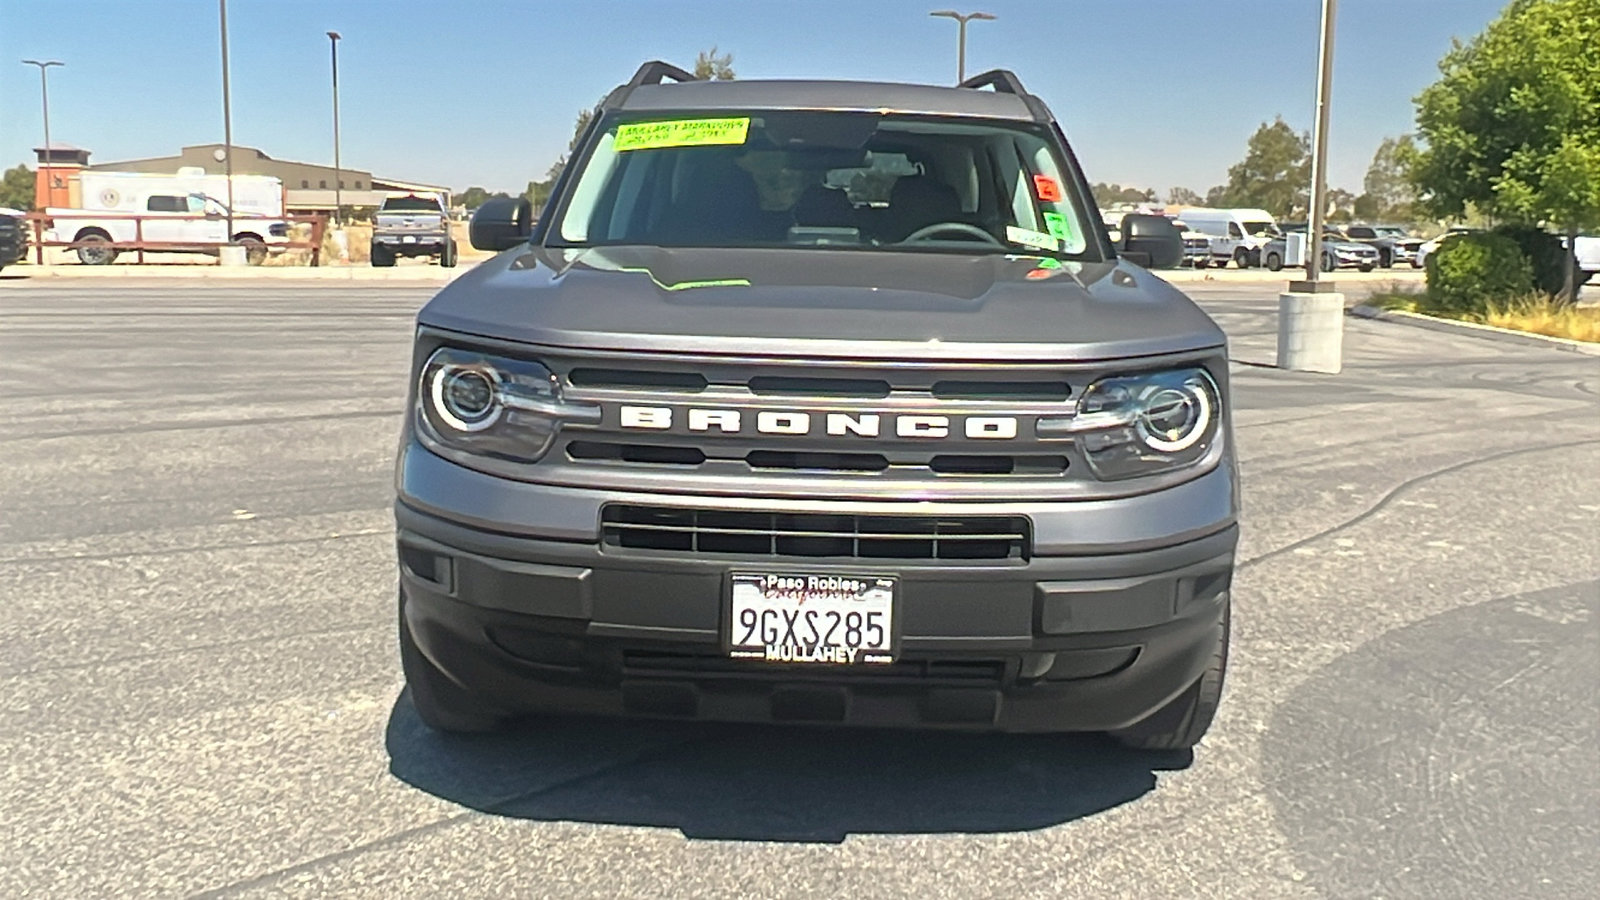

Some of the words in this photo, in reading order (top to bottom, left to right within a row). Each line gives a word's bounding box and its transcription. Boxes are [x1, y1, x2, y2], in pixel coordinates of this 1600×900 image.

[620, 405, 1017, 439] BRONCO
[768, 574, 805, 590] Paso
[808, 575, 860, 591] Robles
[739, 608, 884, 648] 9GXS285
[765, 645, 858, 663] MULLAHEY
